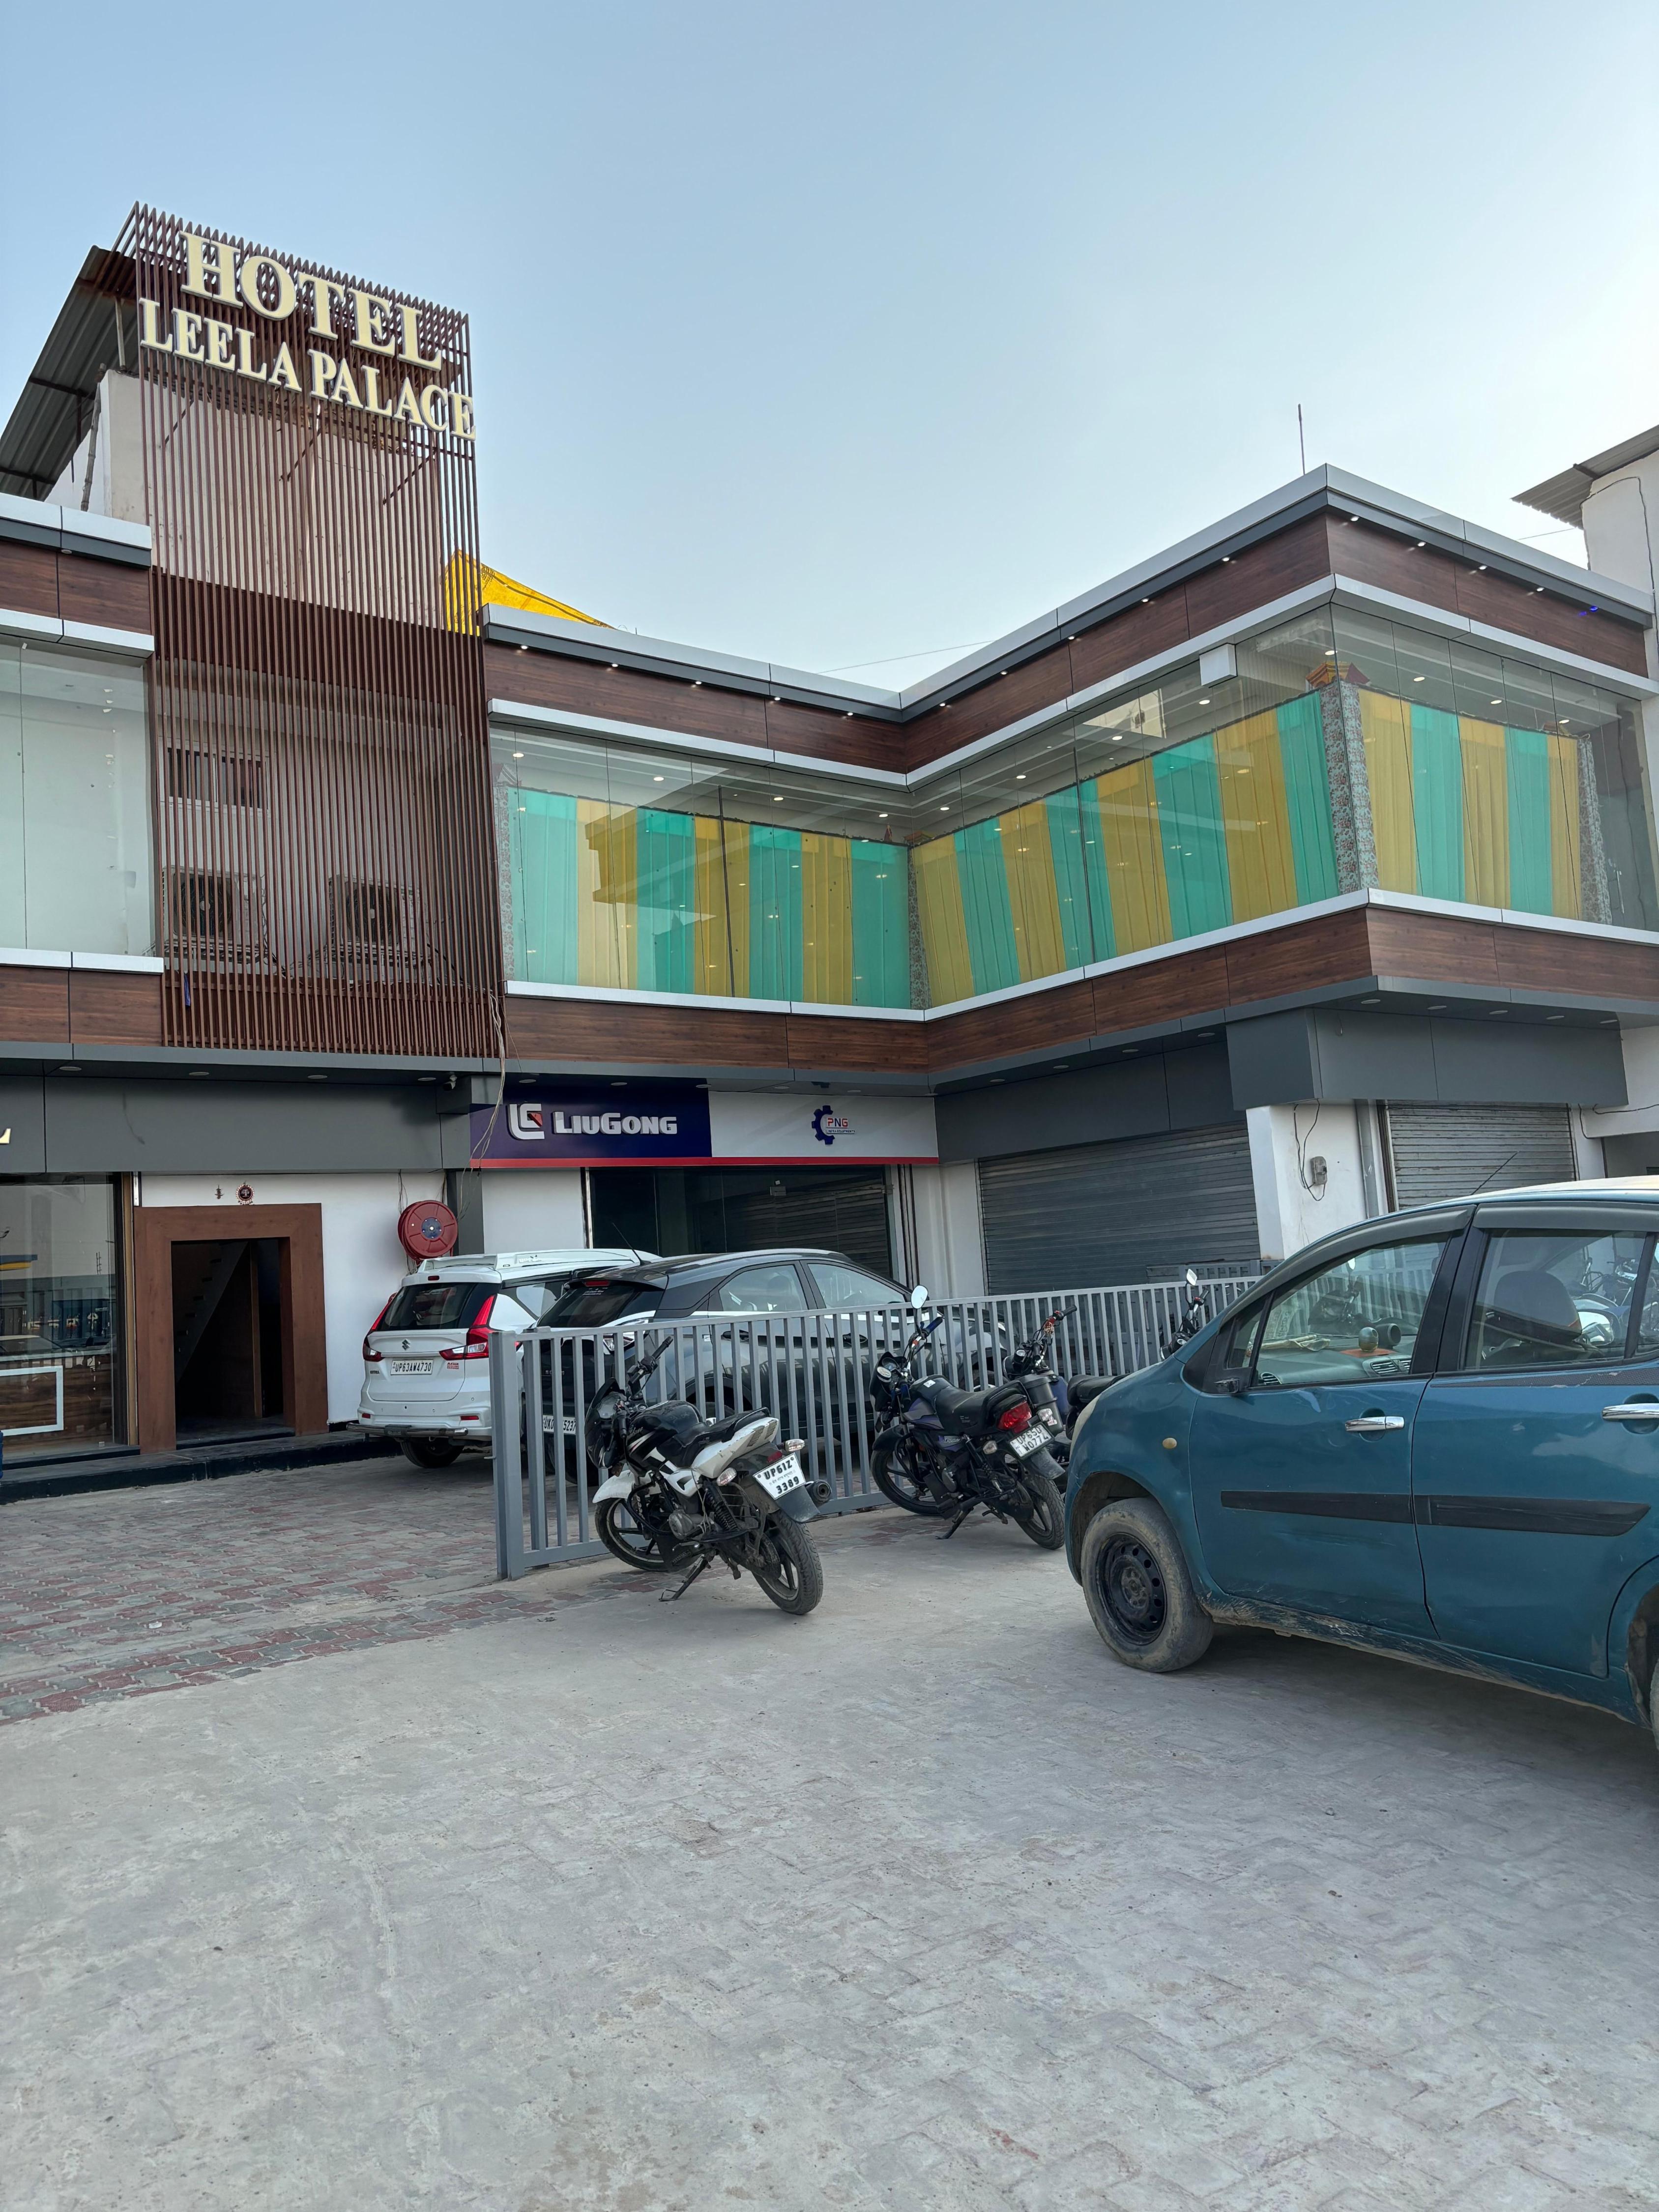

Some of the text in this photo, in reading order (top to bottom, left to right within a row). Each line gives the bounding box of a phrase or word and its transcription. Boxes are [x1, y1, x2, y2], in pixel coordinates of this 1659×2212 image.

[179, 231, 442, 372] HOTEL
[139, 297, 476, 441] LEELA PALACE
[827, 1118, 848, 1127] PNG
[395, 1362, 431, 1372] UP63AW4730
[764, 1460, 792, 1480] UP61Z
[776, 1476, 799, 1494] 3389
